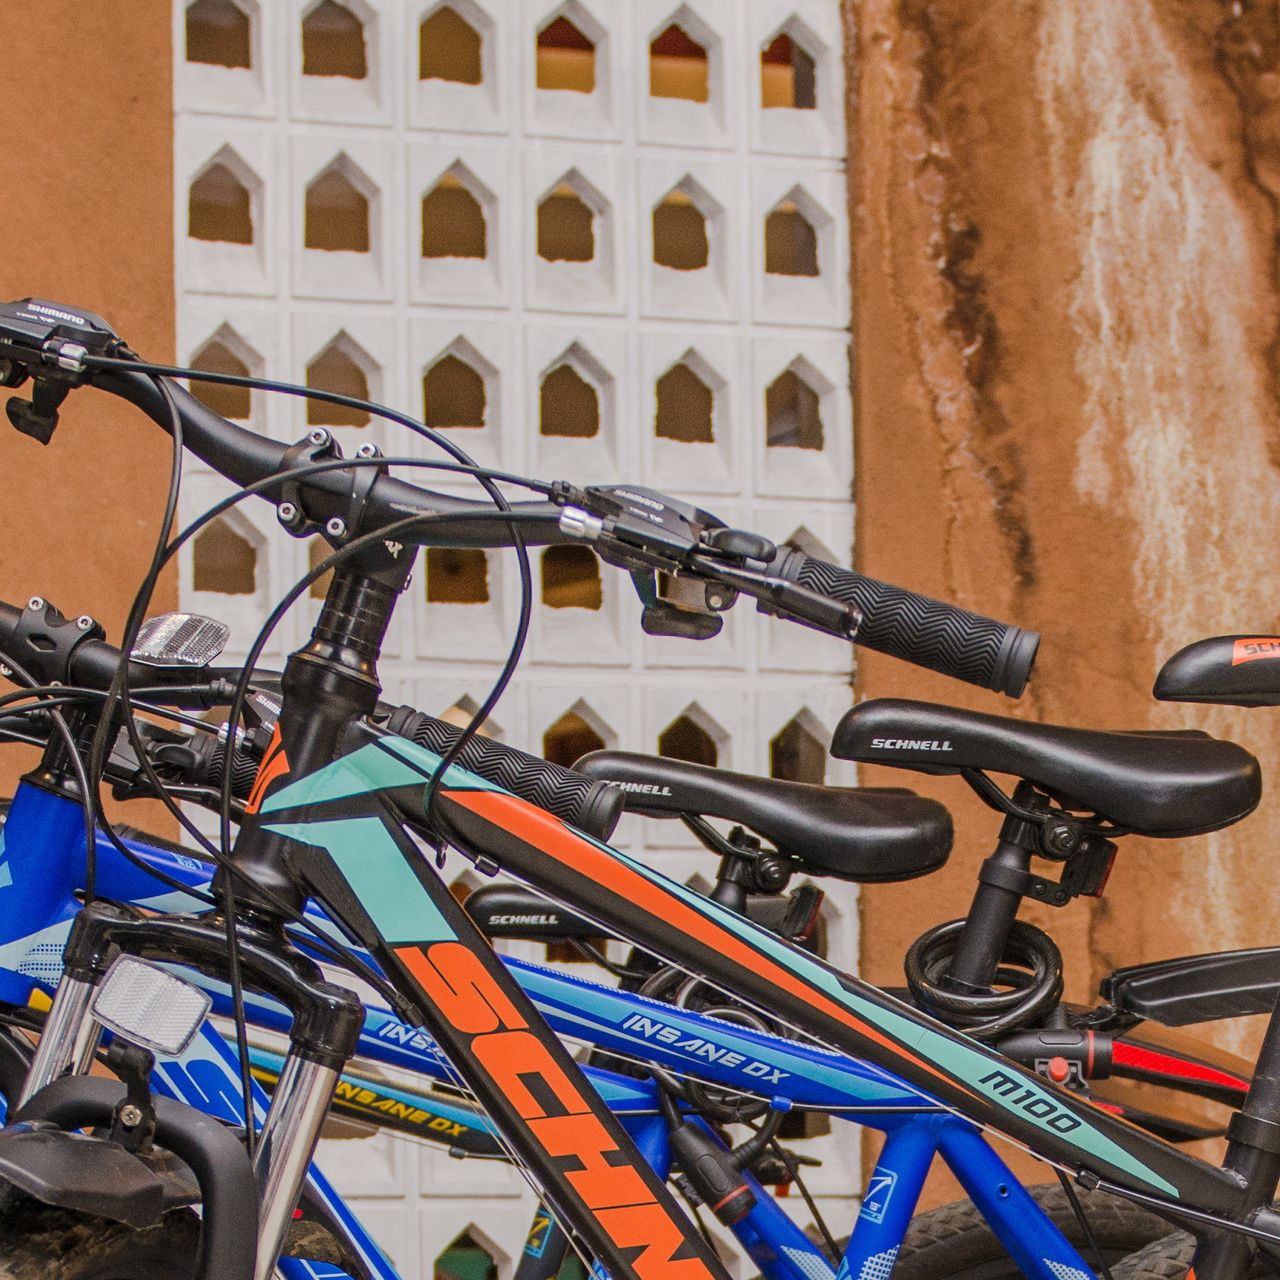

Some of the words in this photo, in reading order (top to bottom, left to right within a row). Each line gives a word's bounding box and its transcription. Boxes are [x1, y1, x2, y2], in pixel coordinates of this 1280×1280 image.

[27, 303, 85, 325] SHIMANO
[870, 738, 953, 751] SCHNELL
[488, 914, 558, 925] SCHNELL
[623, 1014, 747, 1067] INSANE
[742, 1061, 791, 1085] DX
[978, 1070, 1082, 1133] M100
[428, 1116, 469, 1138] DX
